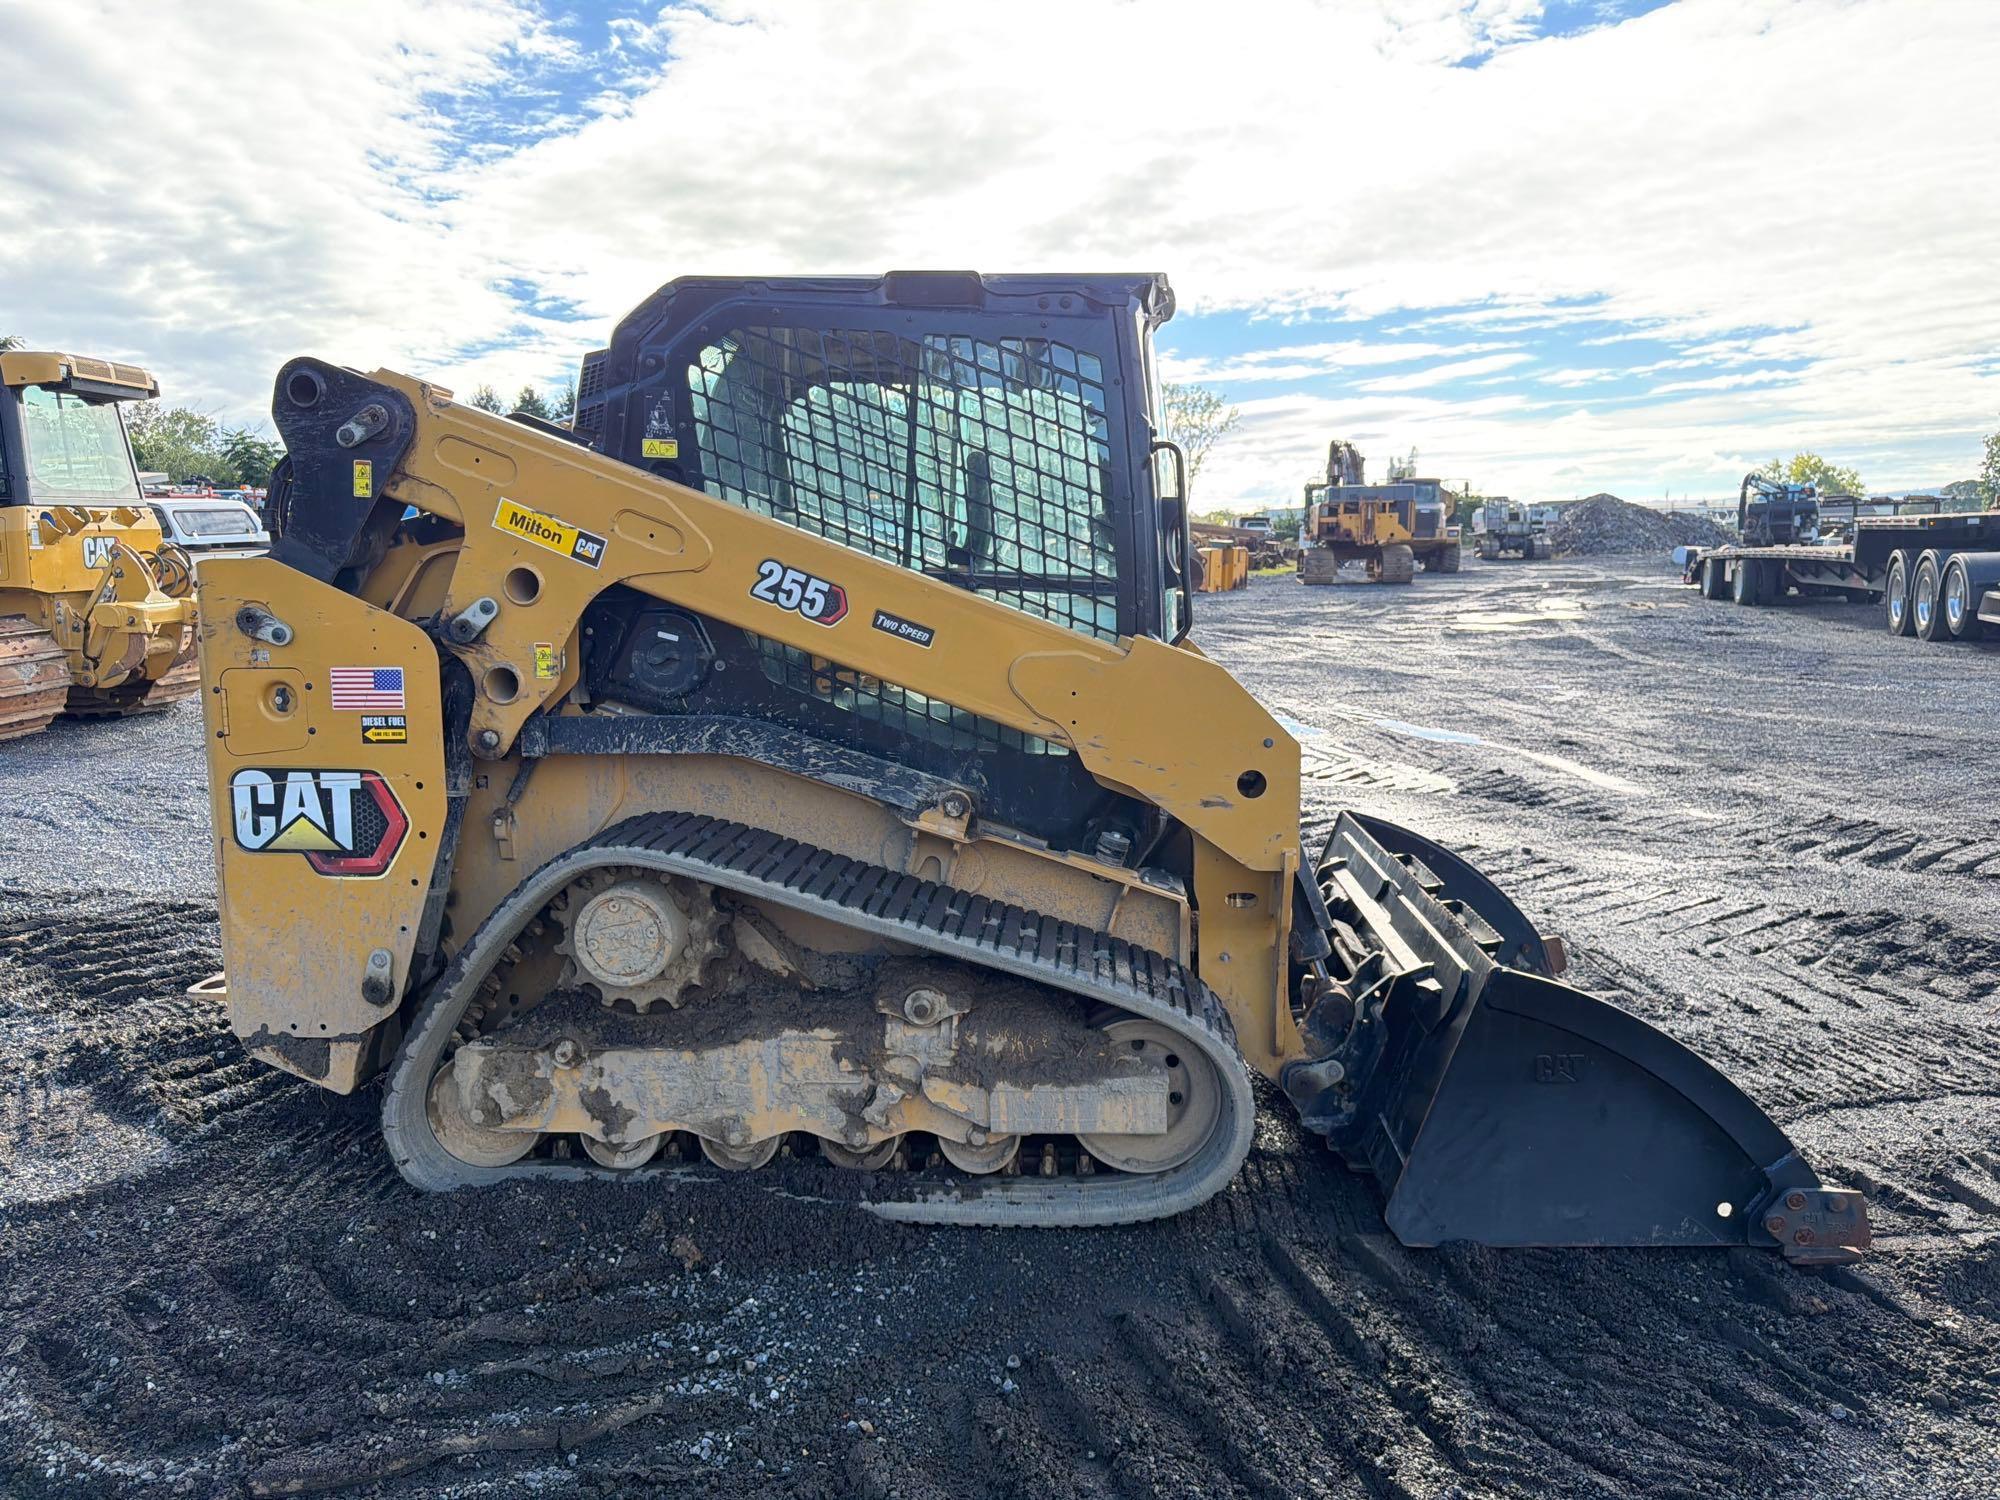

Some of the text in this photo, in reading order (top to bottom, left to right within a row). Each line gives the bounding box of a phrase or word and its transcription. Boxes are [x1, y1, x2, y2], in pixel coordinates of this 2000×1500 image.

[509, 511, 601, 559] Milton CAT
[752, 561, 830, 617] 255
[362, 717, 406, 726] DIESEL FUEL
[233, 769, 361, 850] CAT
[1535, 1053, 1585, 1083] CAT
